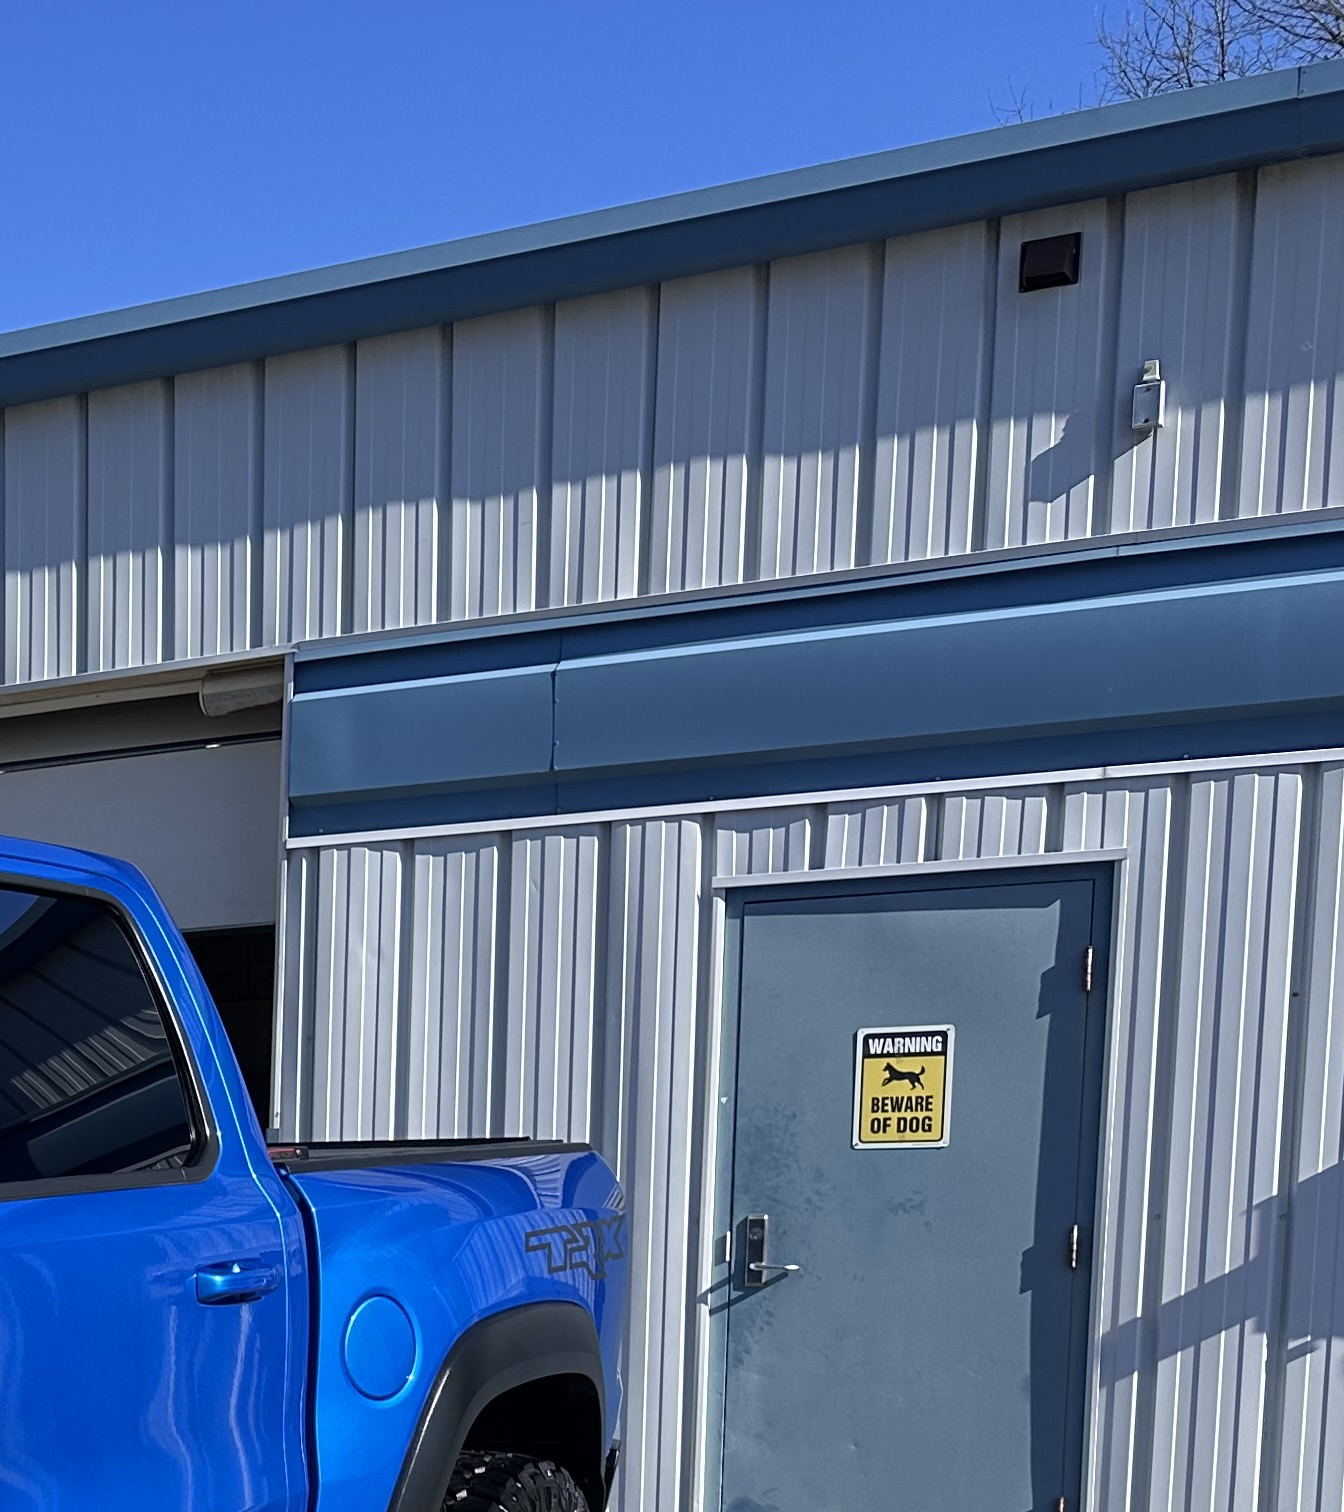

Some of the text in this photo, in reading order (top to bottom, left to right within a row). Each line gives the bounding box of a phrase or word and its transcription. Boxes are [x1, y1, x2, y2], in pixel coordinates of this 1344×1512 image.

[868, 1035, 943, 1055] WARNING
[870, 1094, 934, 1114] BEWARE
[869, 1115, 933, 1134] OF DOG
[524, 1212, 626, 1281] TRX
